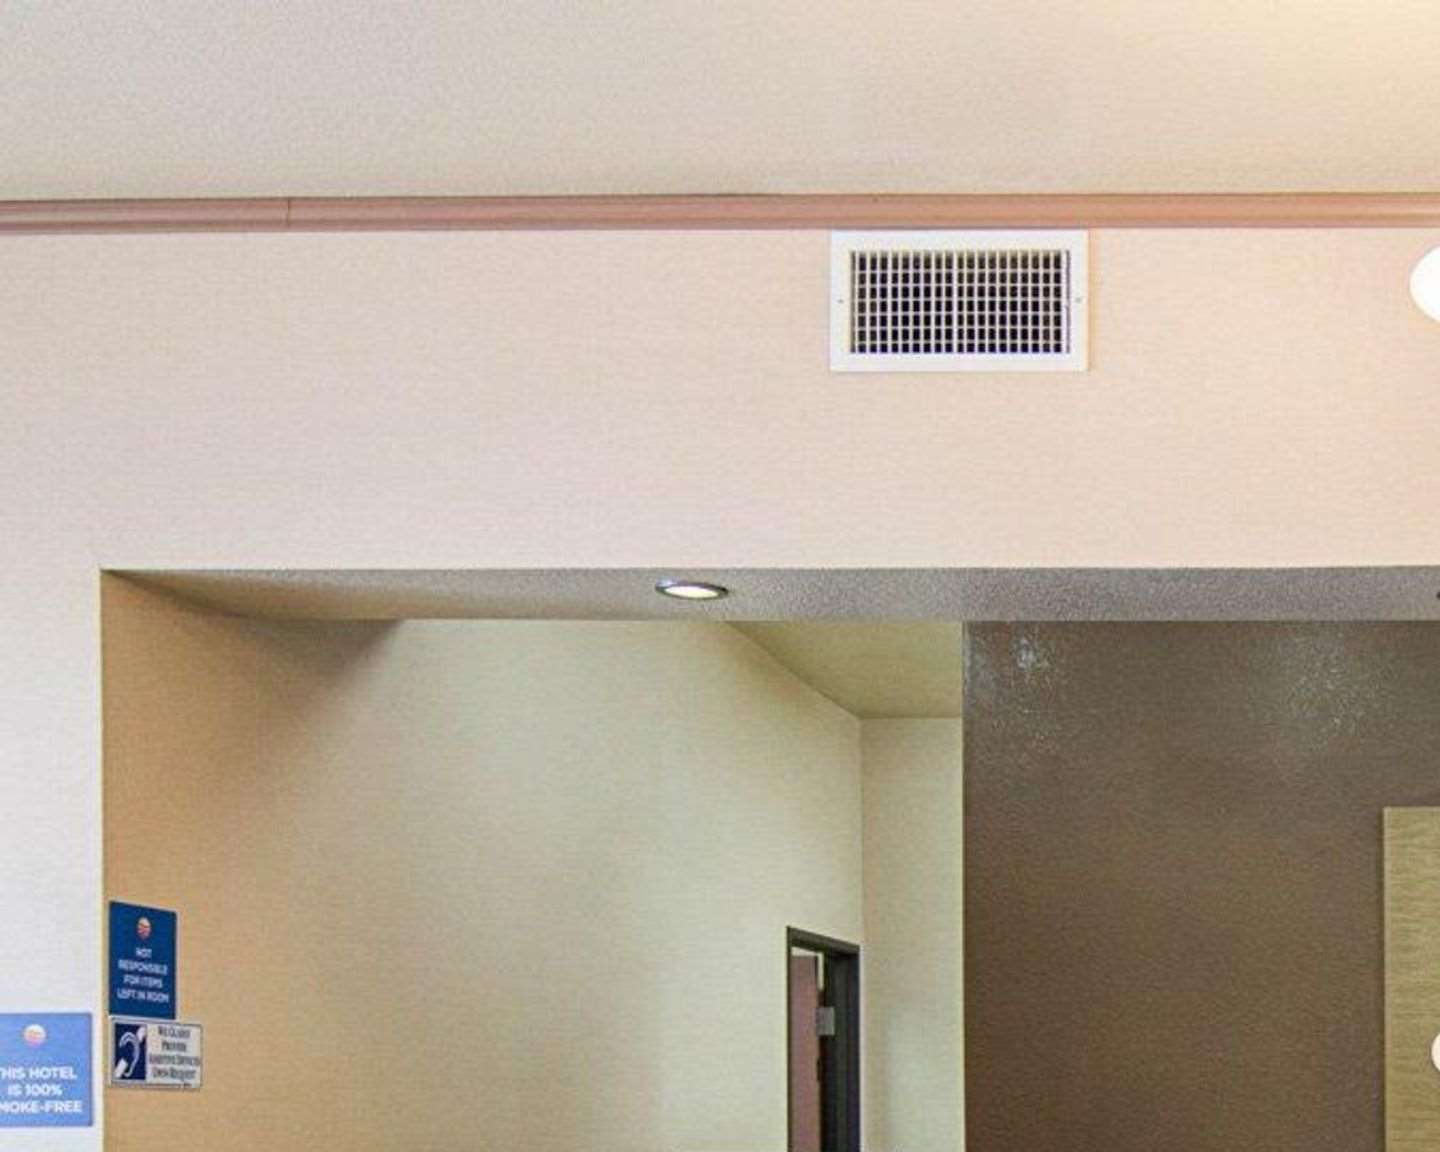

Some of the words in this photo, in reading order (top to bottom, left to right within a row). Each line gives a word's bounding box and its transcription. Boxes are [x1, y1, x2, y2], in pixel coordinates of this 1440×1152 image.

[135, 947, 153, 959] NOT
[118, 959, 168, 977] RESPONSIBLE
[123, 975, 139, 986] FOR
[140, 976, 163, 989] ITEMS
[116, 988, 136, 1000] LEFT
[146, 991, 169, 1003] ROOM
[0, 1066, 25, 1080] THIS
[29, 1066, 78, 1080] HOTEL
[7, 1084, 22, 1096] IS
[25, 1083, 62, 1096] 100%
[0, 1099, 83, 1113] MOKE-FREE
